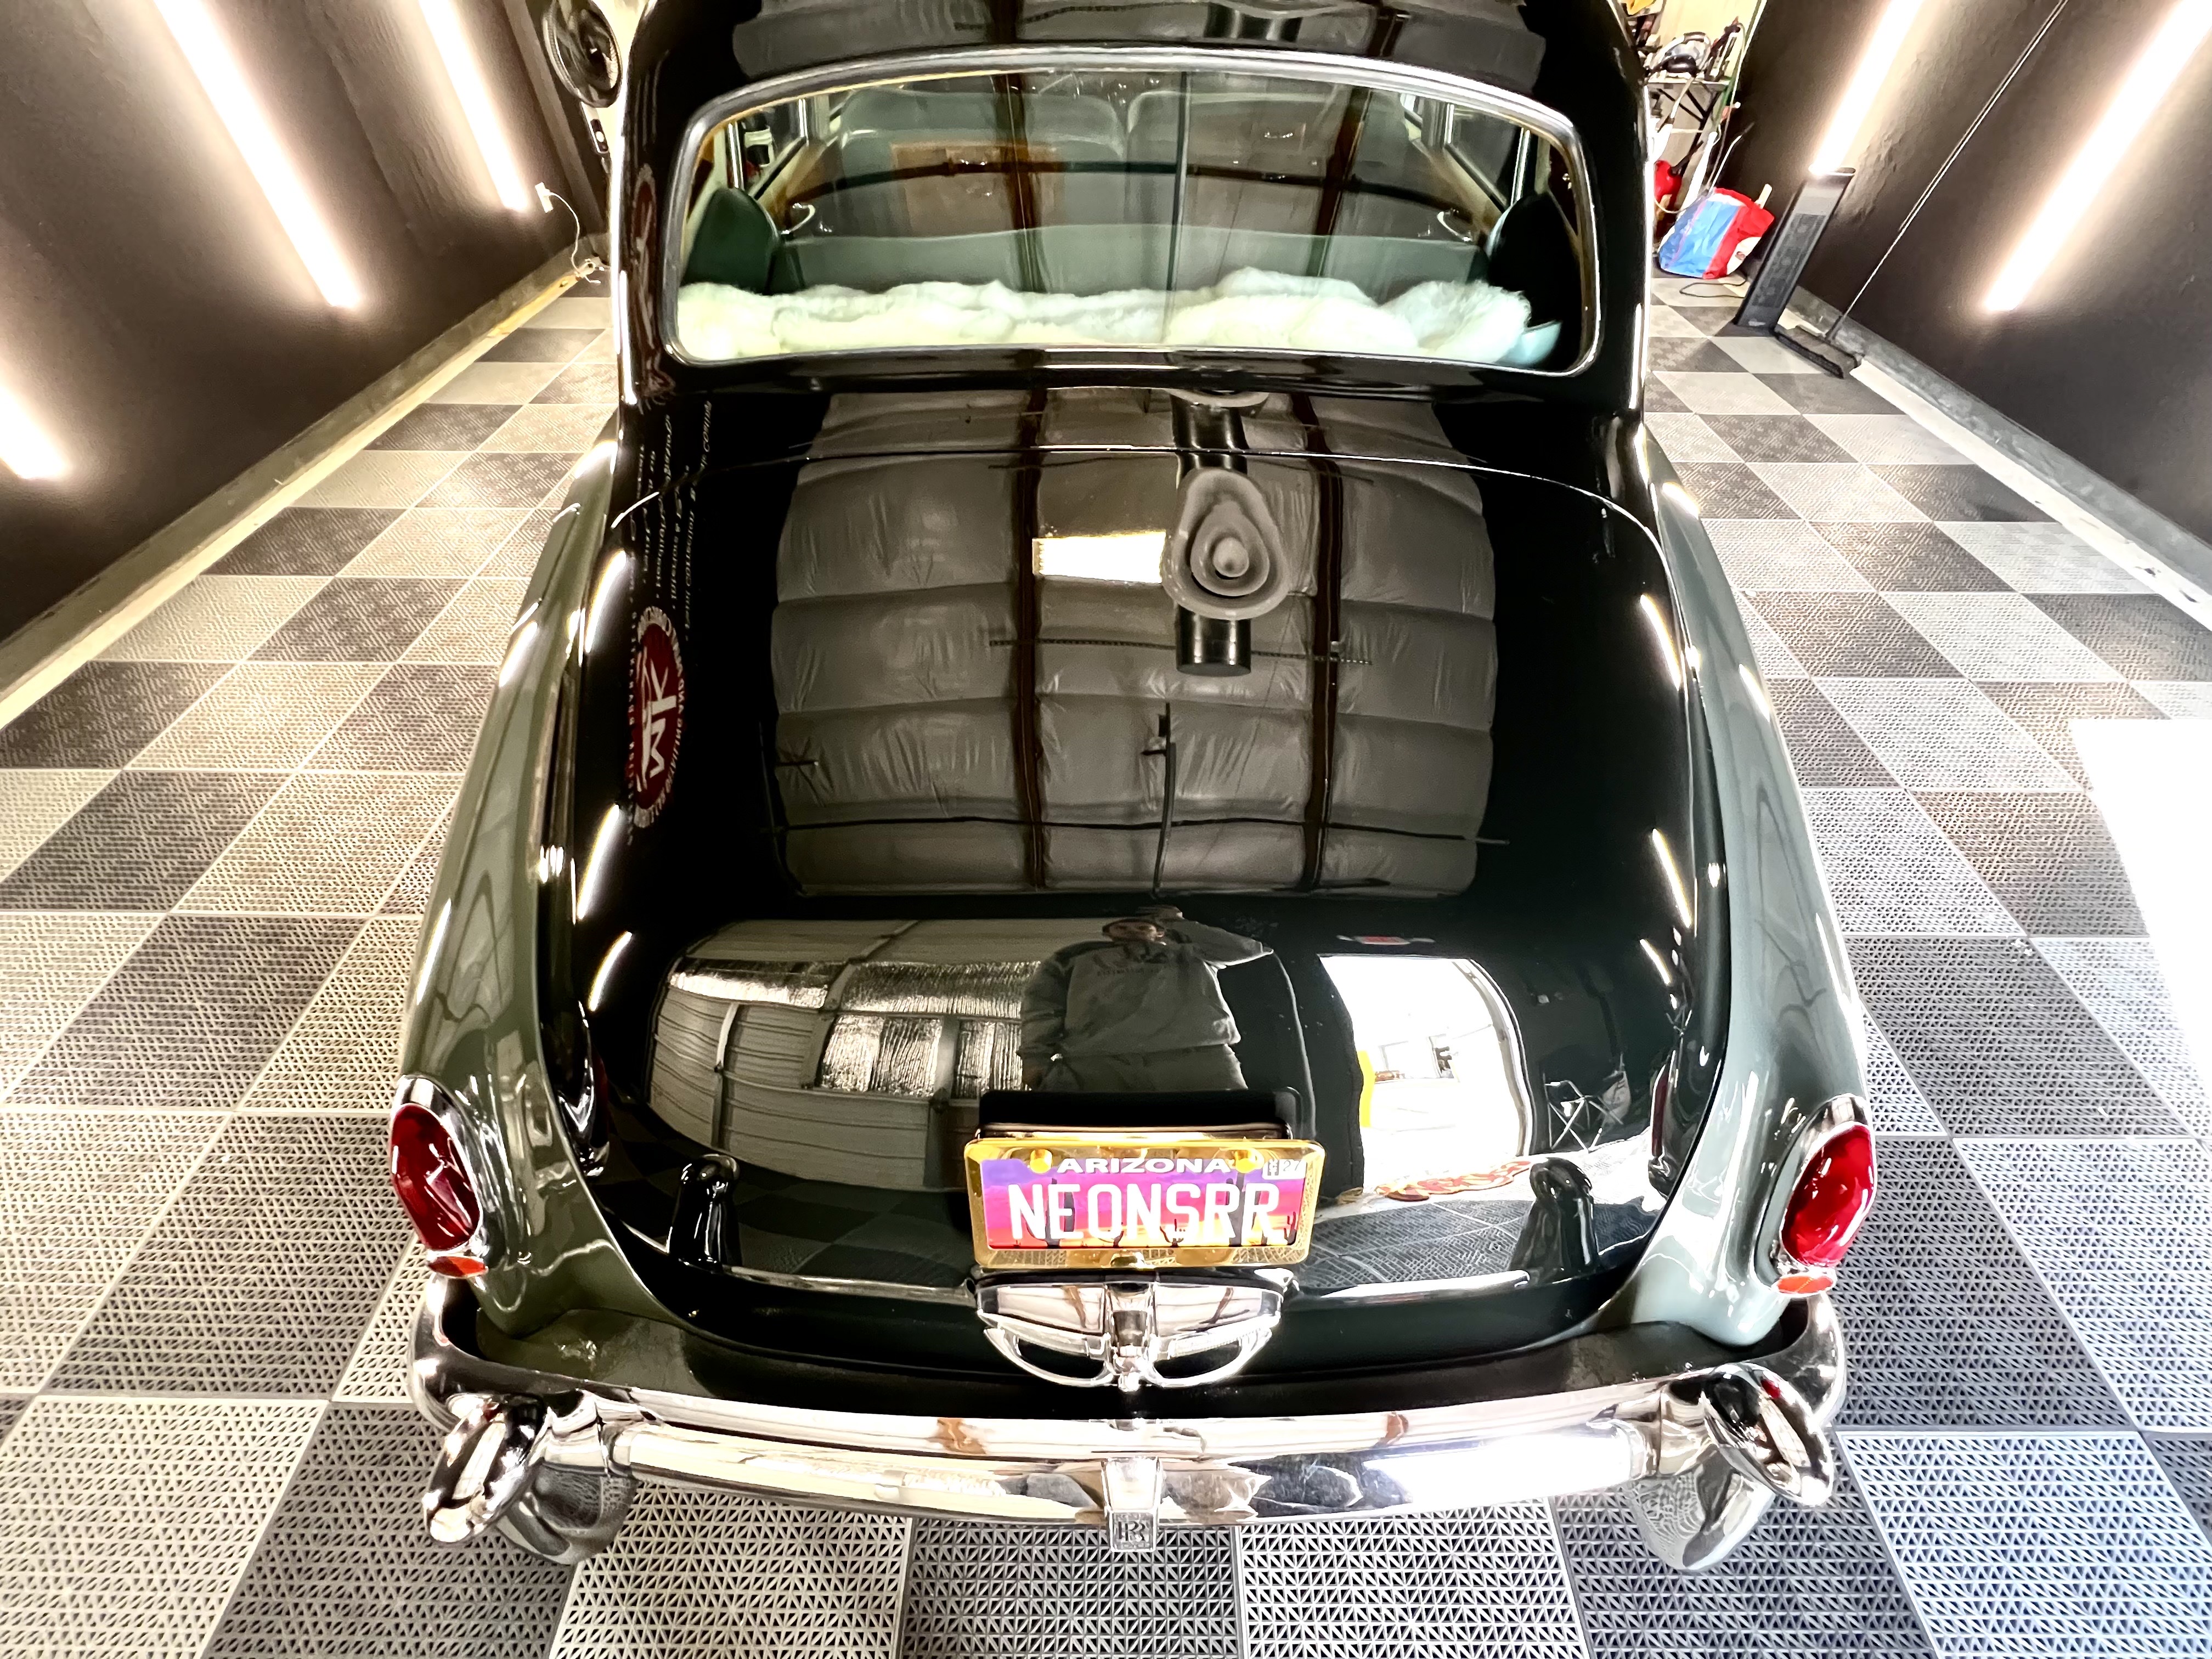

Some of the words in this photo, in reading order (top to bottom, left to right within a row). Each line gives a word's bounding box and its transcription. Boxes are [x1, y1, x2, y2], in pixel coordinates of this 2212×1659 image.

[1056, 1156, 1233, 1173] ARIZONA
[1283, 1159, 1302, 1172] 27
[1007, 1183, 1284, 1240] NEONSRR
